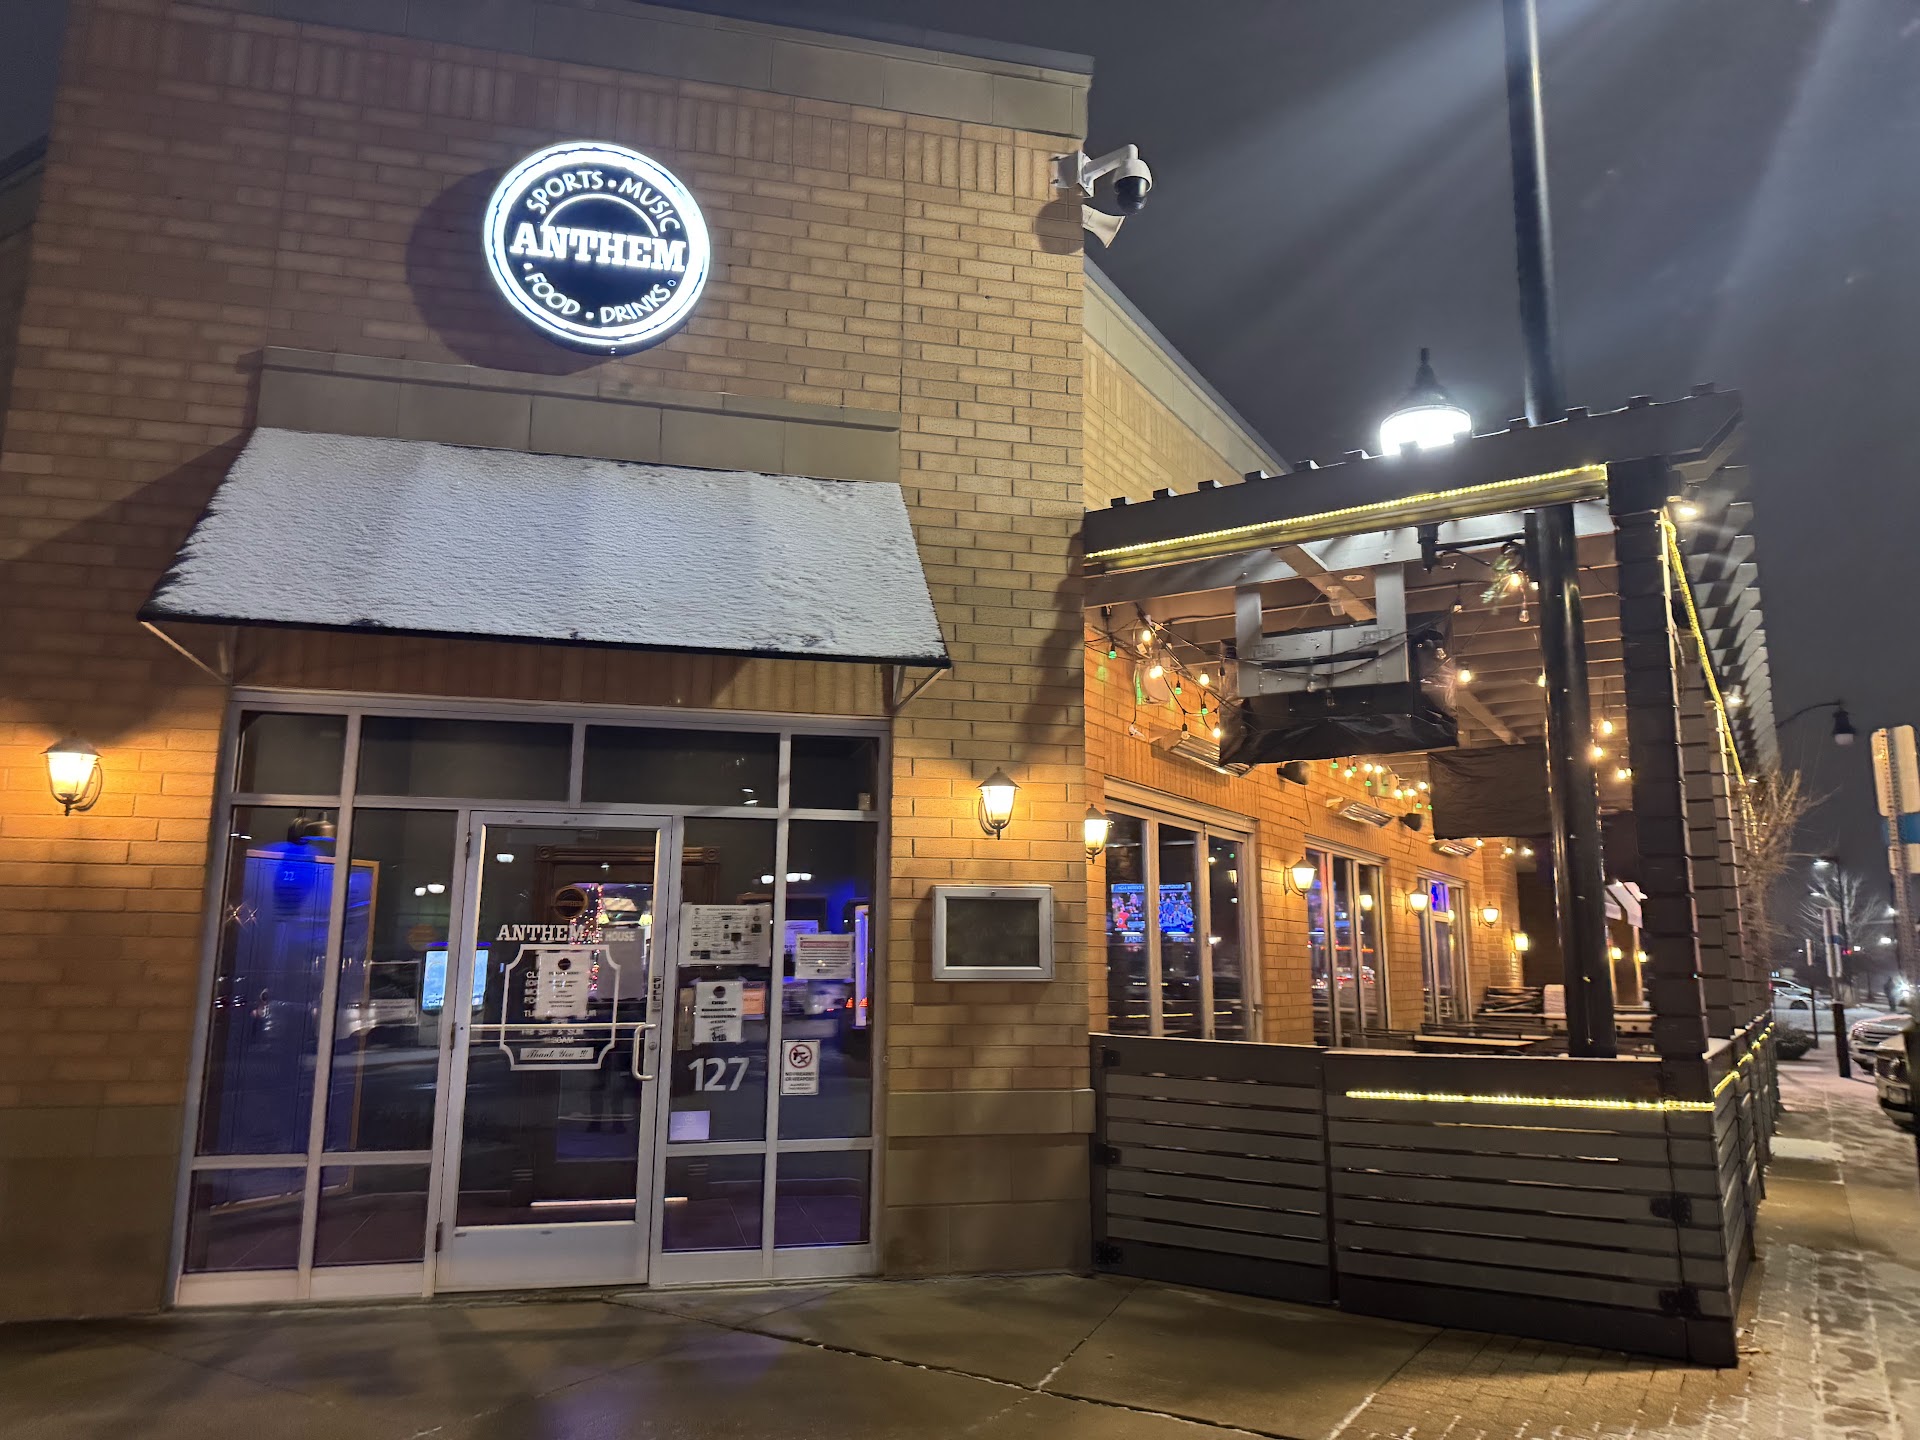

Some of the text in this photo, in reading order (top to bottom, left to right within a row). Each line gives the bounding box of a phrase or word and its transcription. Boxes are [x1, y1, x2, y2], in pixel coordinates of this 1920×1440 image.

[526, 170, 681, 233] SPORTS MUSIC
[509, 222, 687, 273] ANTHEM
[525, 271, 671, 323] FOOD DRINKS
[496, 924, 585, 942] ANTHEM
[605, 930, 635, 942] HOUSE
[653, 977, 662, 1002] PULL
[527, 1049, 555, 1058] Thank
[559, 1049, 575, 1058] You
[688, 1057, 750, 1092] 127
